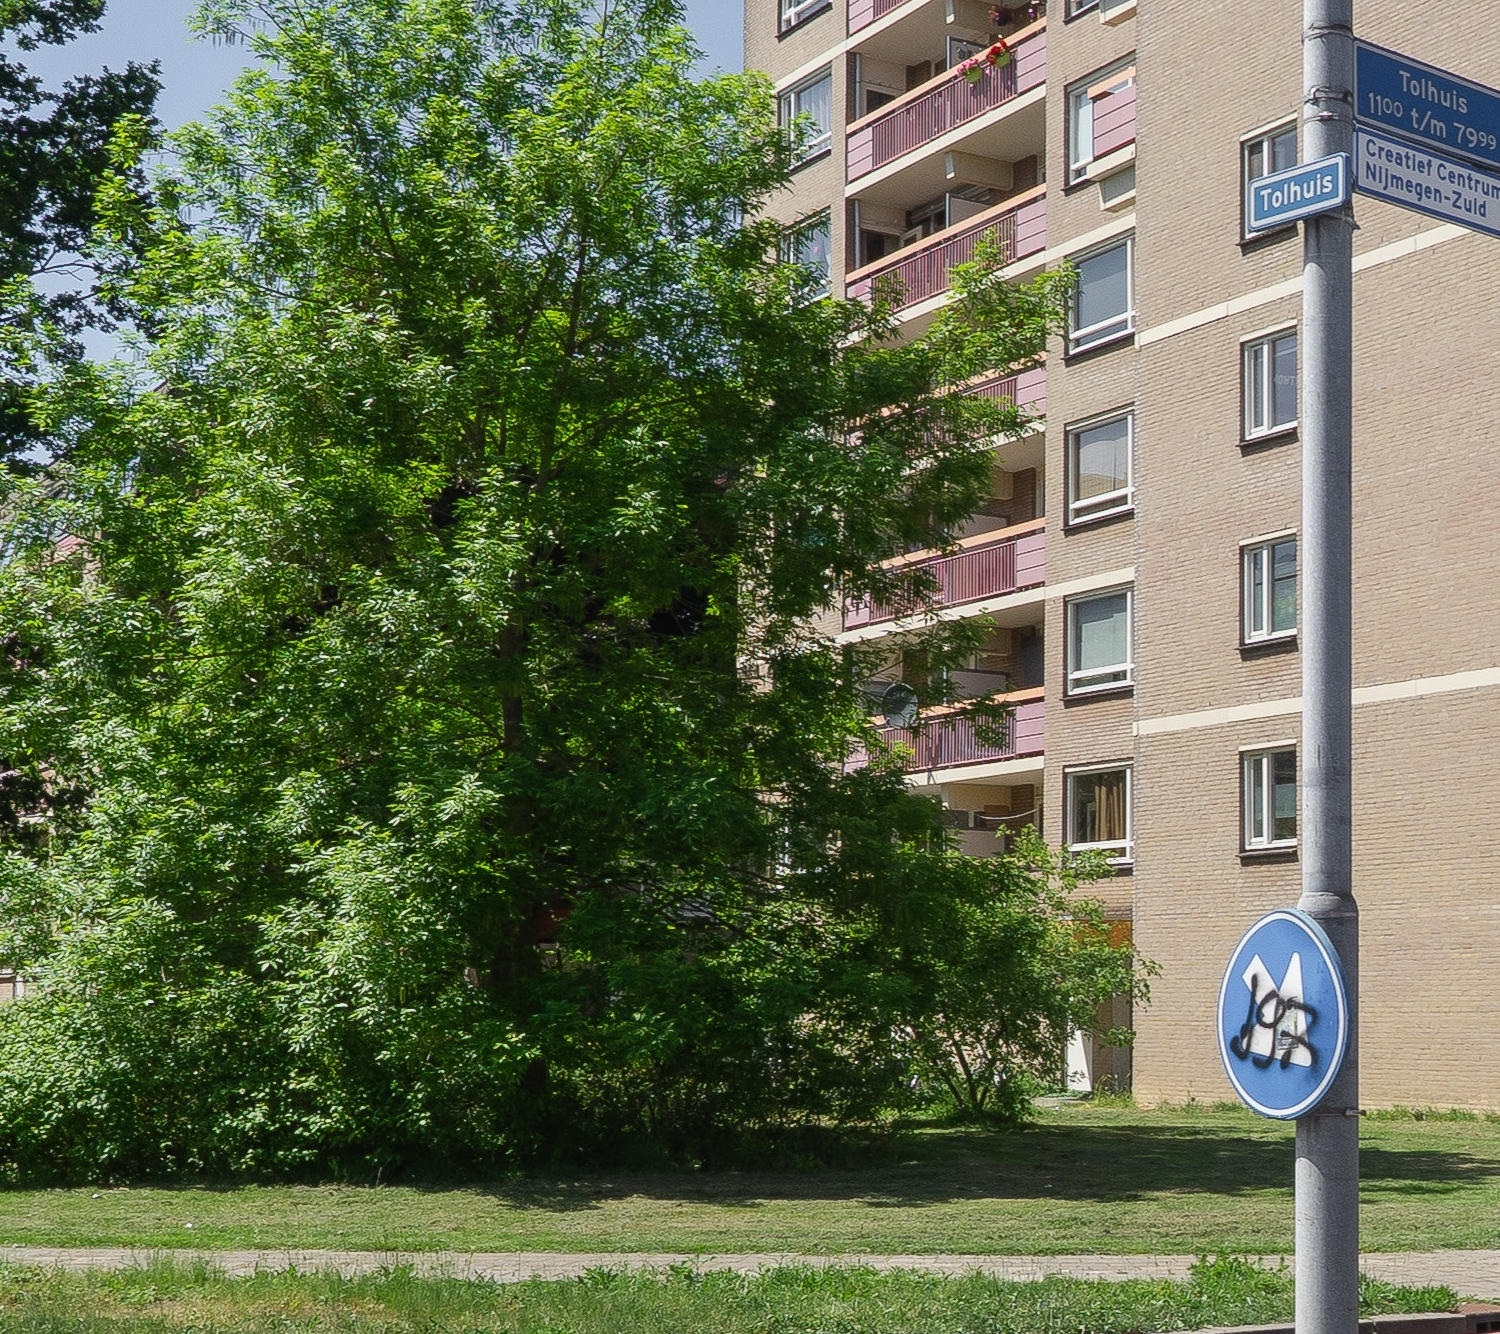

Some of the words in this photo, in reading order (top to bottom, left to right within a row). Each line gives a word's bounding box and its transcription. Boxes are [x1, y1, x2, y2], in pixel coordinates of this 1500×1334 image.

[1399, 70, 1468, 114] Tolhuis
[1368, 92, 1403, 117] 1100
[1411, 108, 1446, 138] t/m
[1453, 122, 1497, 150] 7999
[1365, 138, 1432, 176] Creatief
[1260, 173, 1333, 212] Tolhuis
[1365, 161, 1487, 218] Nijmegen-Zuid
